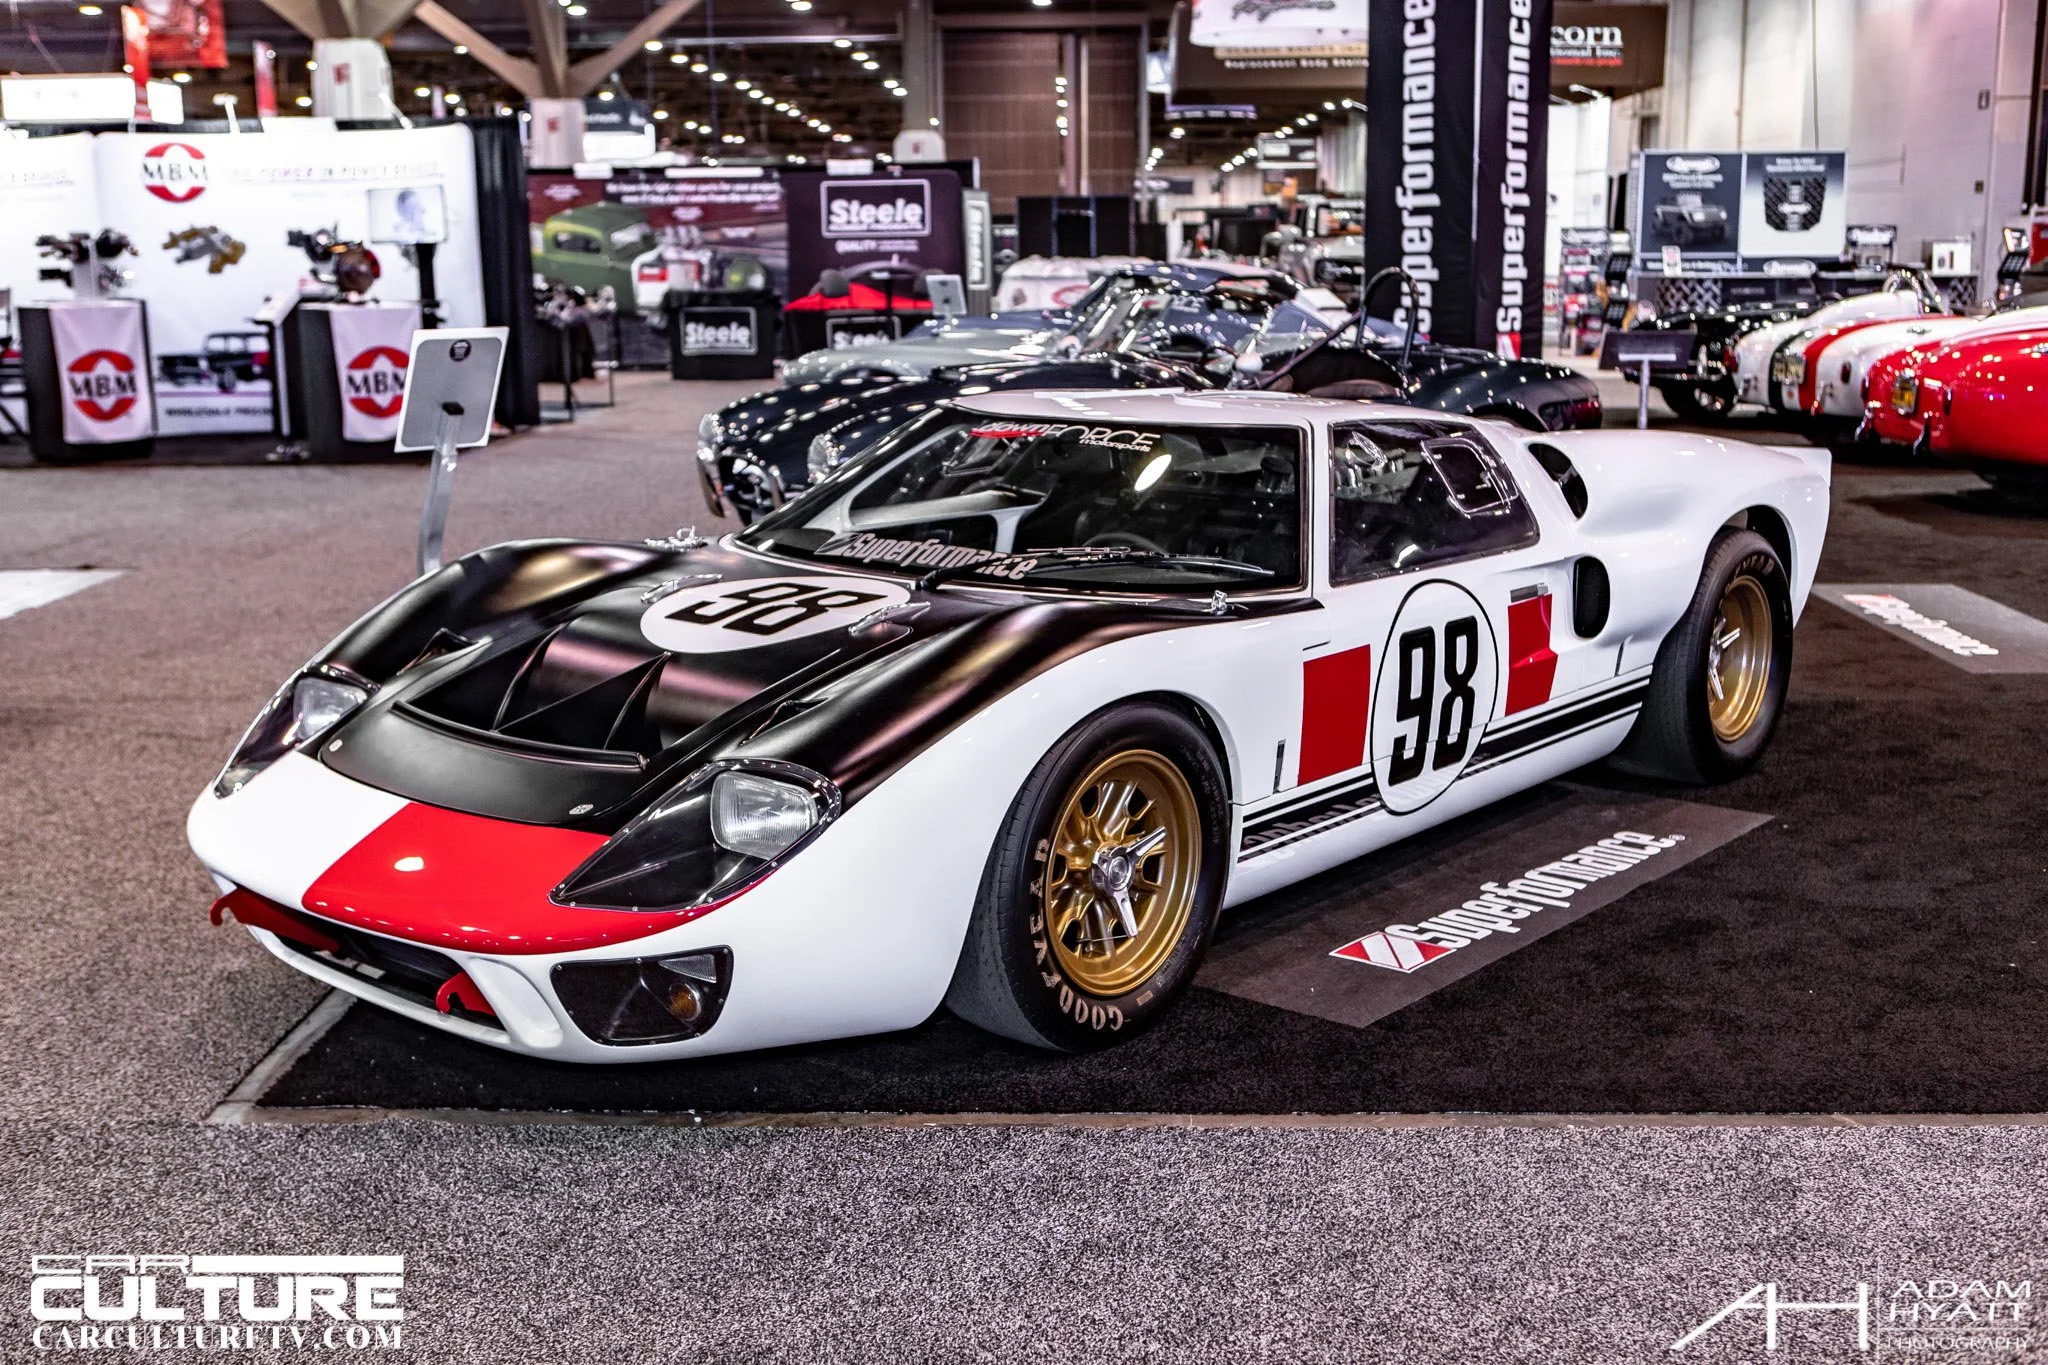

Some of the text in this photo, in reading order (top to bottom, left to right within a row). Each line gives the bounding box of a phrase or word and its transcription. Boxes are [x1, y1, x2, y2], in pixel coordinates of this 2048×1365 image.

[143, 162, 208, 181] MBM
[829, 198, 923, 224] Steele
[685, 321, 750, 342] Steele
[69, 372, 137, 398] MBM
[1079, 438, 1152, 453] motorsports
[665, 582, 888, 636] 98
[1388, 615, 1478, 787] 98
